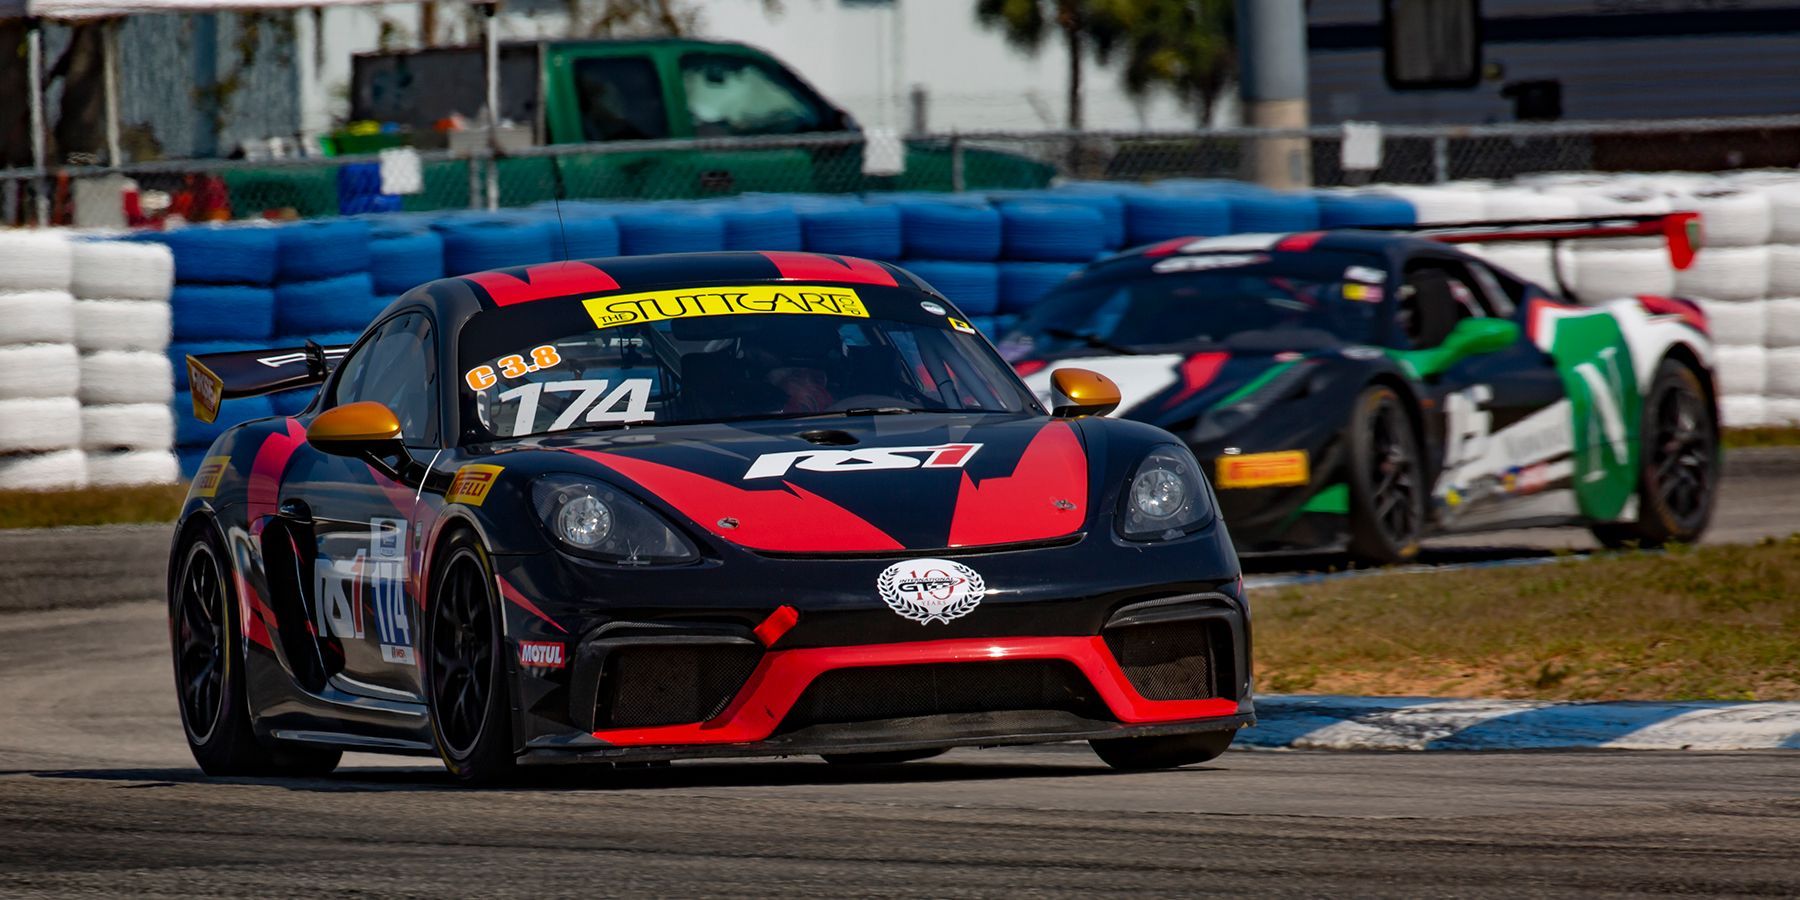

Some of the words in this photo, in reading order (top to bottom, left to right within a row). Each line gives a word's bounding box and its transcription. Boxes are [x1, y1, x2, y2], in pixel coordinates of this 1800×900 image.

[602, 292, 851, 325] STUTTGART
[466, 366, 497, 391] C
[498, 345, 561, 379] 3.8
[499, 378, 655, 437] 174
[522, 644, 562, 664] MOTUL
